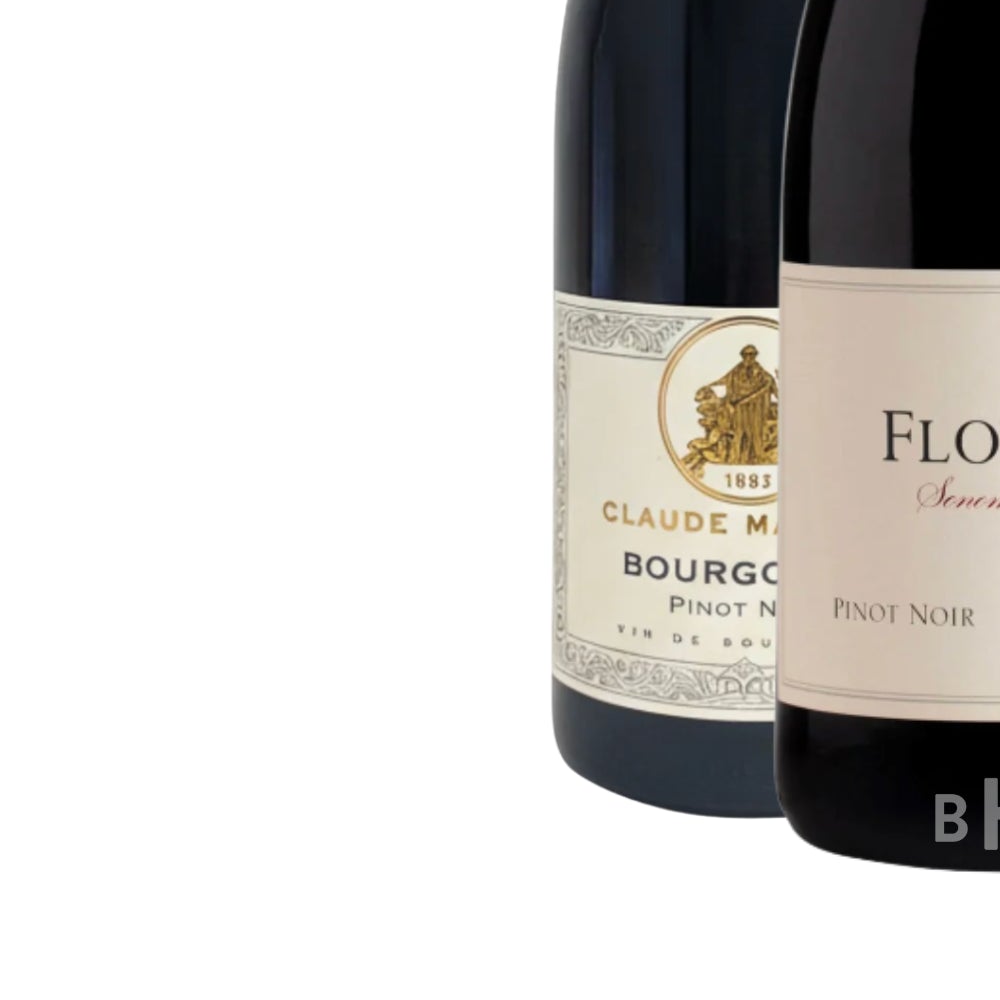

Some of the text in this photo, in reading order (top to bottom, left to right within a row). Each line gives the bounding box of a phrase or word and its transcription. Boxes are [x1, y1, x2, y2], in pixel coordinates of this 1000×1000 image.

[725, 473, 772, 489] 1883
[602, 500, 778, 536] CLAUDE M
[624, 551, 778, 586] BOURGO
[669, 595, 748, 618] PINOT
[834, 597, 975, 628] PINOT NOIR
[672, 633, 700, 646] DE
